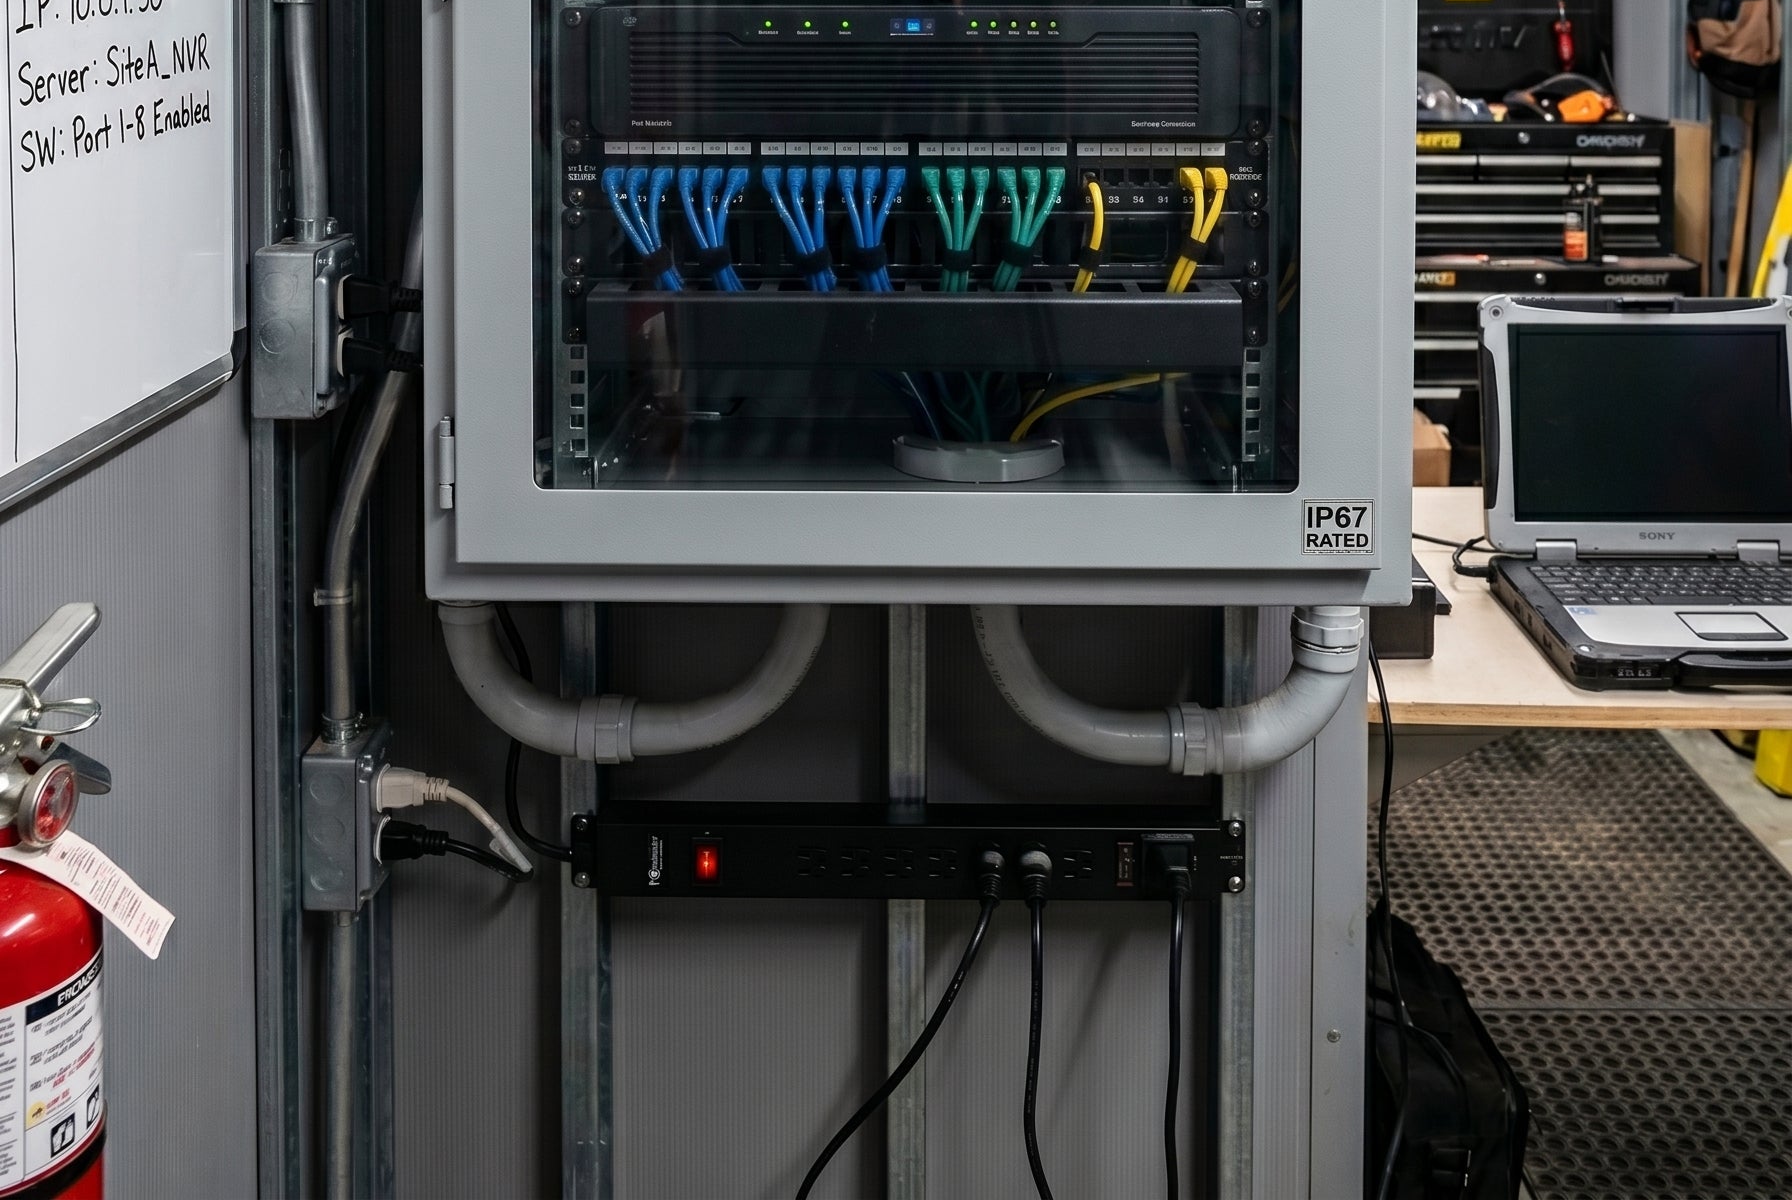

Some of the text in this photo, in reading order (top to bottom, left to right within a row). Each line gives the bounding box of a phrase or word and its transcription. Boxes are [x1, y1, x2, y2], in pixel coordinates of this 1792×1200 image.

[18, 32, 210, 107] Server: SiteA_NVR
[21, 89, 211, 173] SW: Port 1-8 Enabled
[1306, 506, 1369, 548] IP67 RATED
[1638, 531, 1676, 541] SONY
